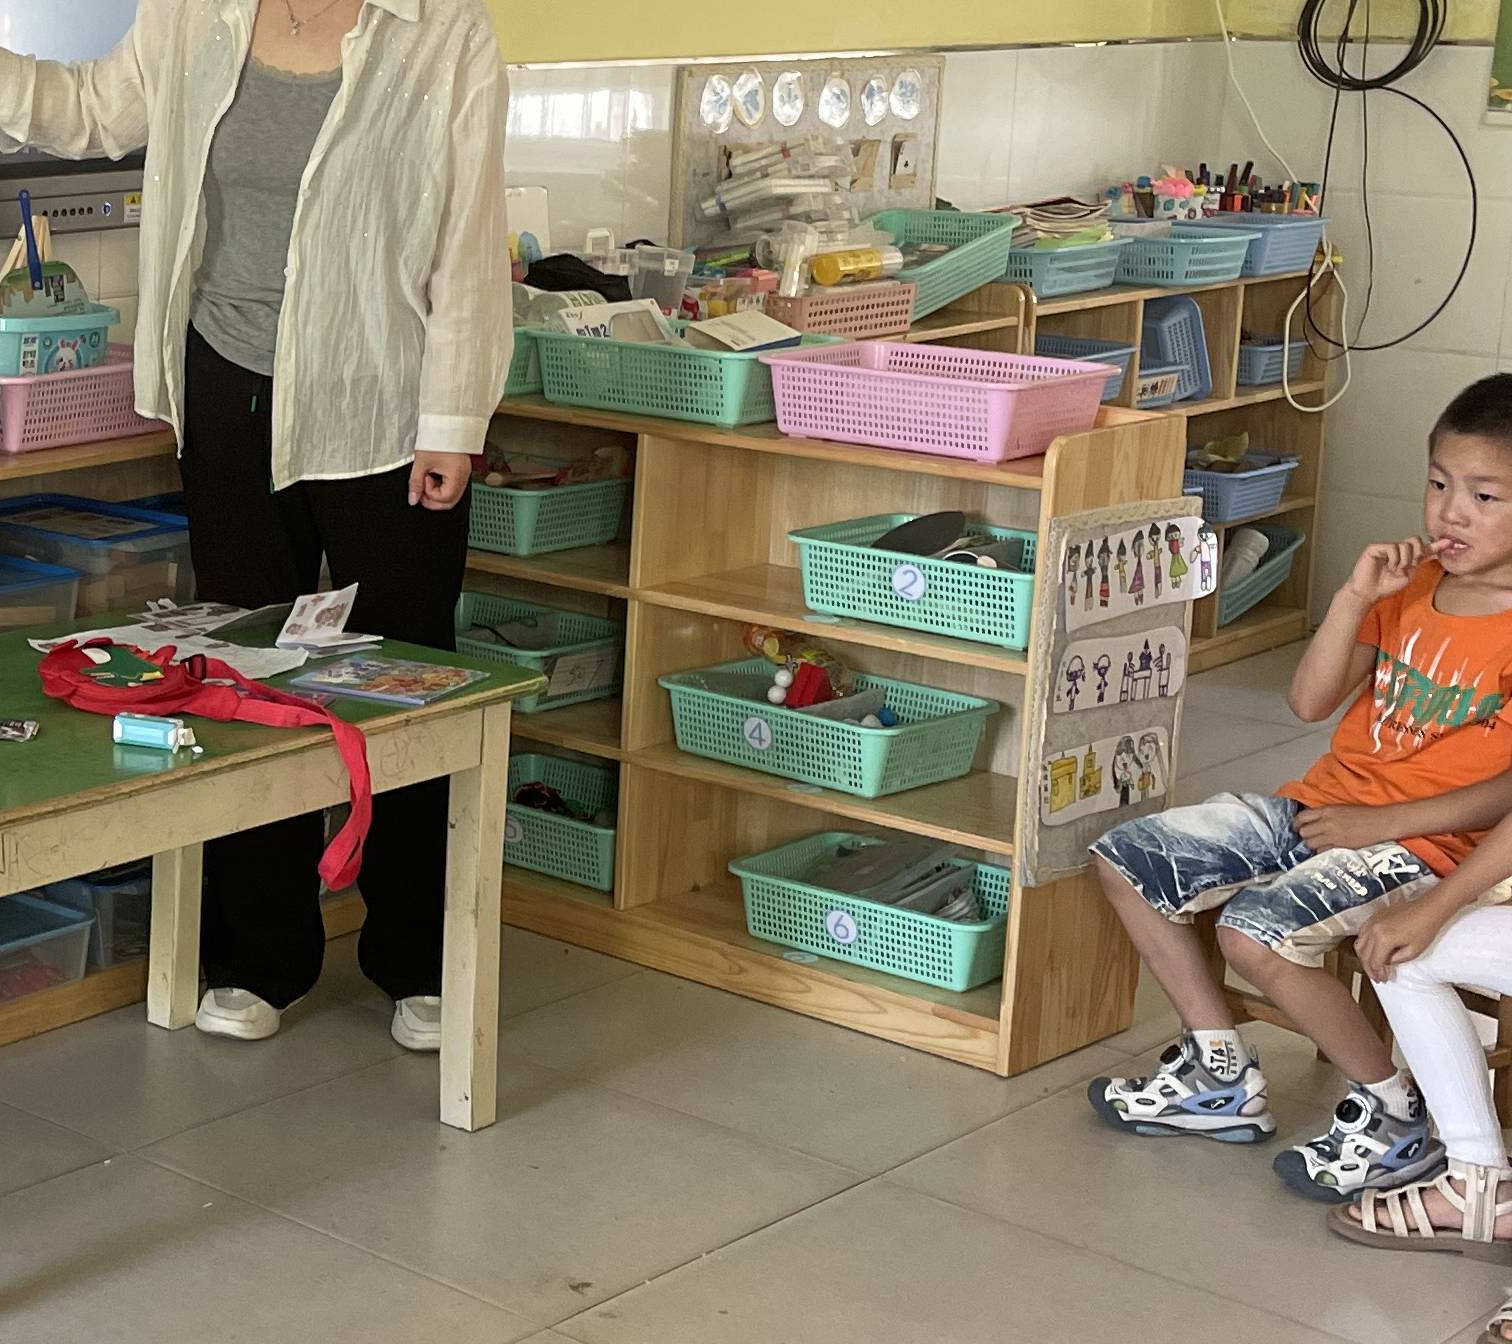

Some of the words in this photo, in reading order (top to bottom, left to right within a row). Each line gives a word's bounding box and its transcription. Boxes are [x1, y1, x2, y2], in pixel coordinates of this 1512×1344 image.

[898, 570, 919, 595] 2
[750, 722, 767, 744] 4
[833, 916, 850, 941] 6
